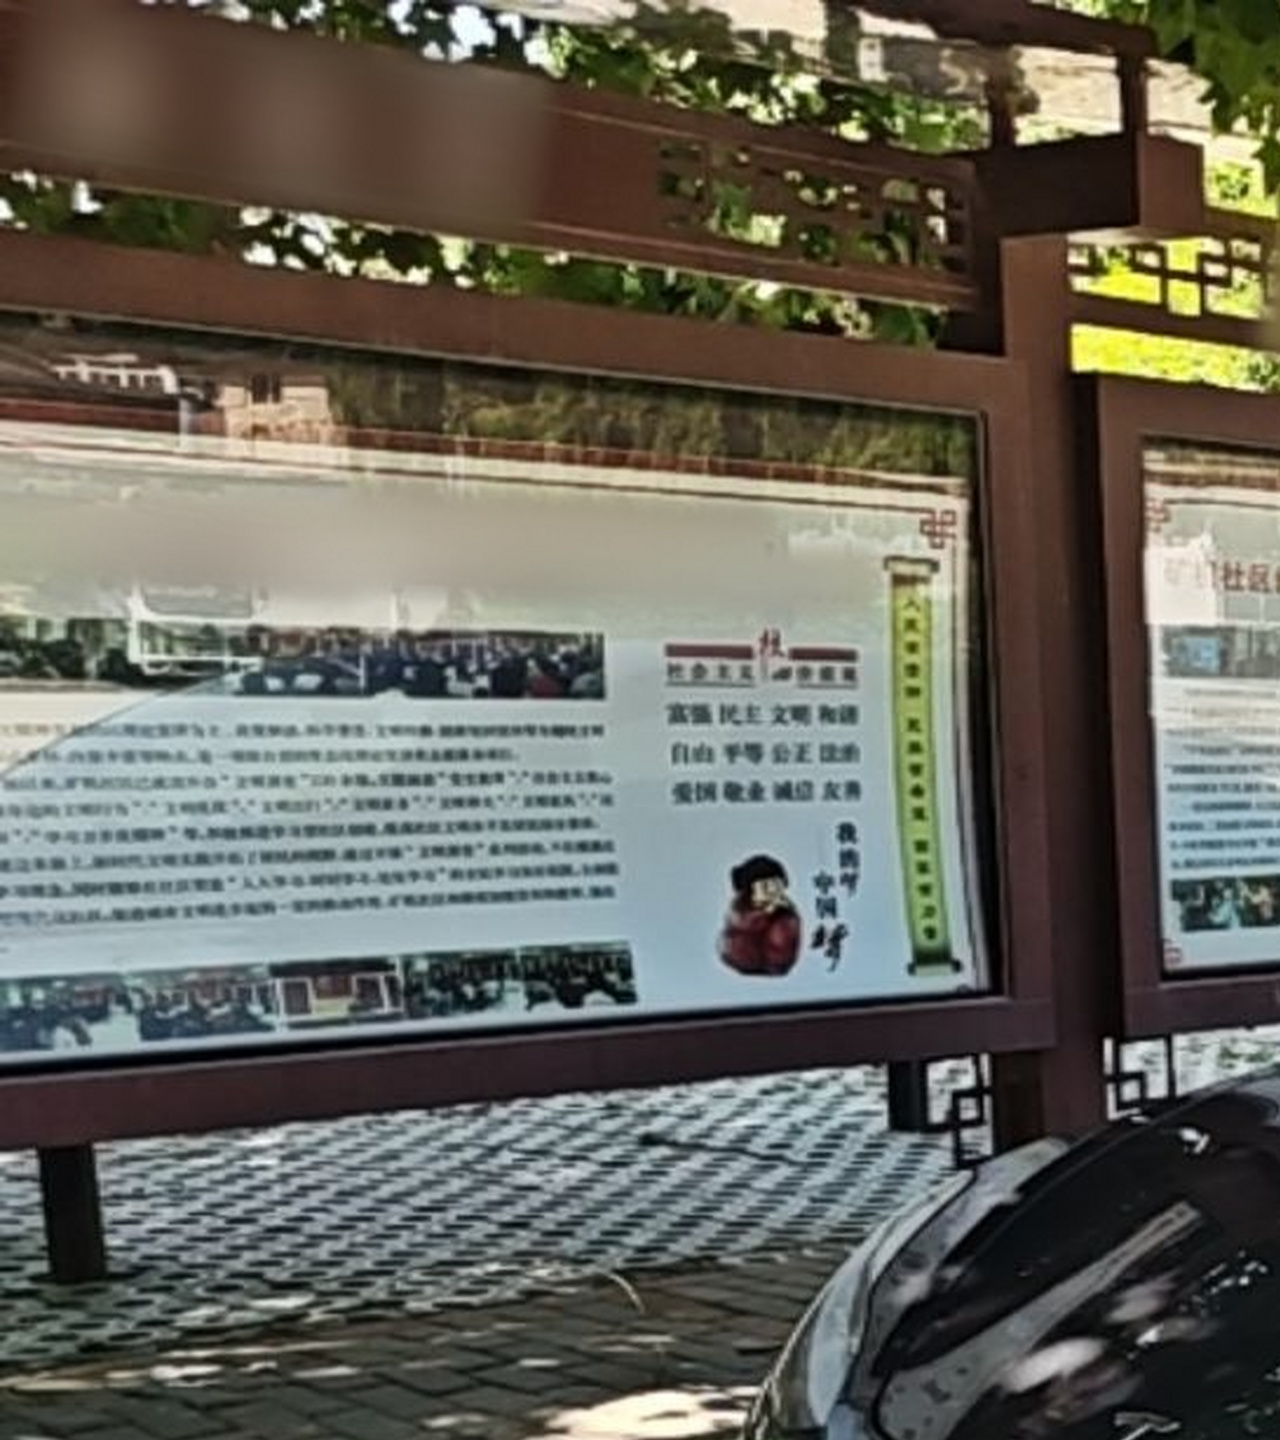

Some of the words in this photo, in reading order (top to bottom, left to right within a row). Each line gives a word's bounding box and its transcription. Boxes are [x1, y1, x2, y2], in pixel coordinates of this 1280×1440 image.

[719, 703, 765, 726] 民主
[771, 703, 813, 726] 文明
[818, 704, 859, 725] 和谐
[671, 742, 714, 765] 自由
[724, 742, 764, 765] 平等
[772, 742, 813, 764] 公正
[819, 742, 860, 764] 法治
[672, 781, 717, 804] 爱国
[723, 780, 765, 803] 敬业
[773, 780, 814, 802] 诚信
[822, 779, 862, 801] 友善
